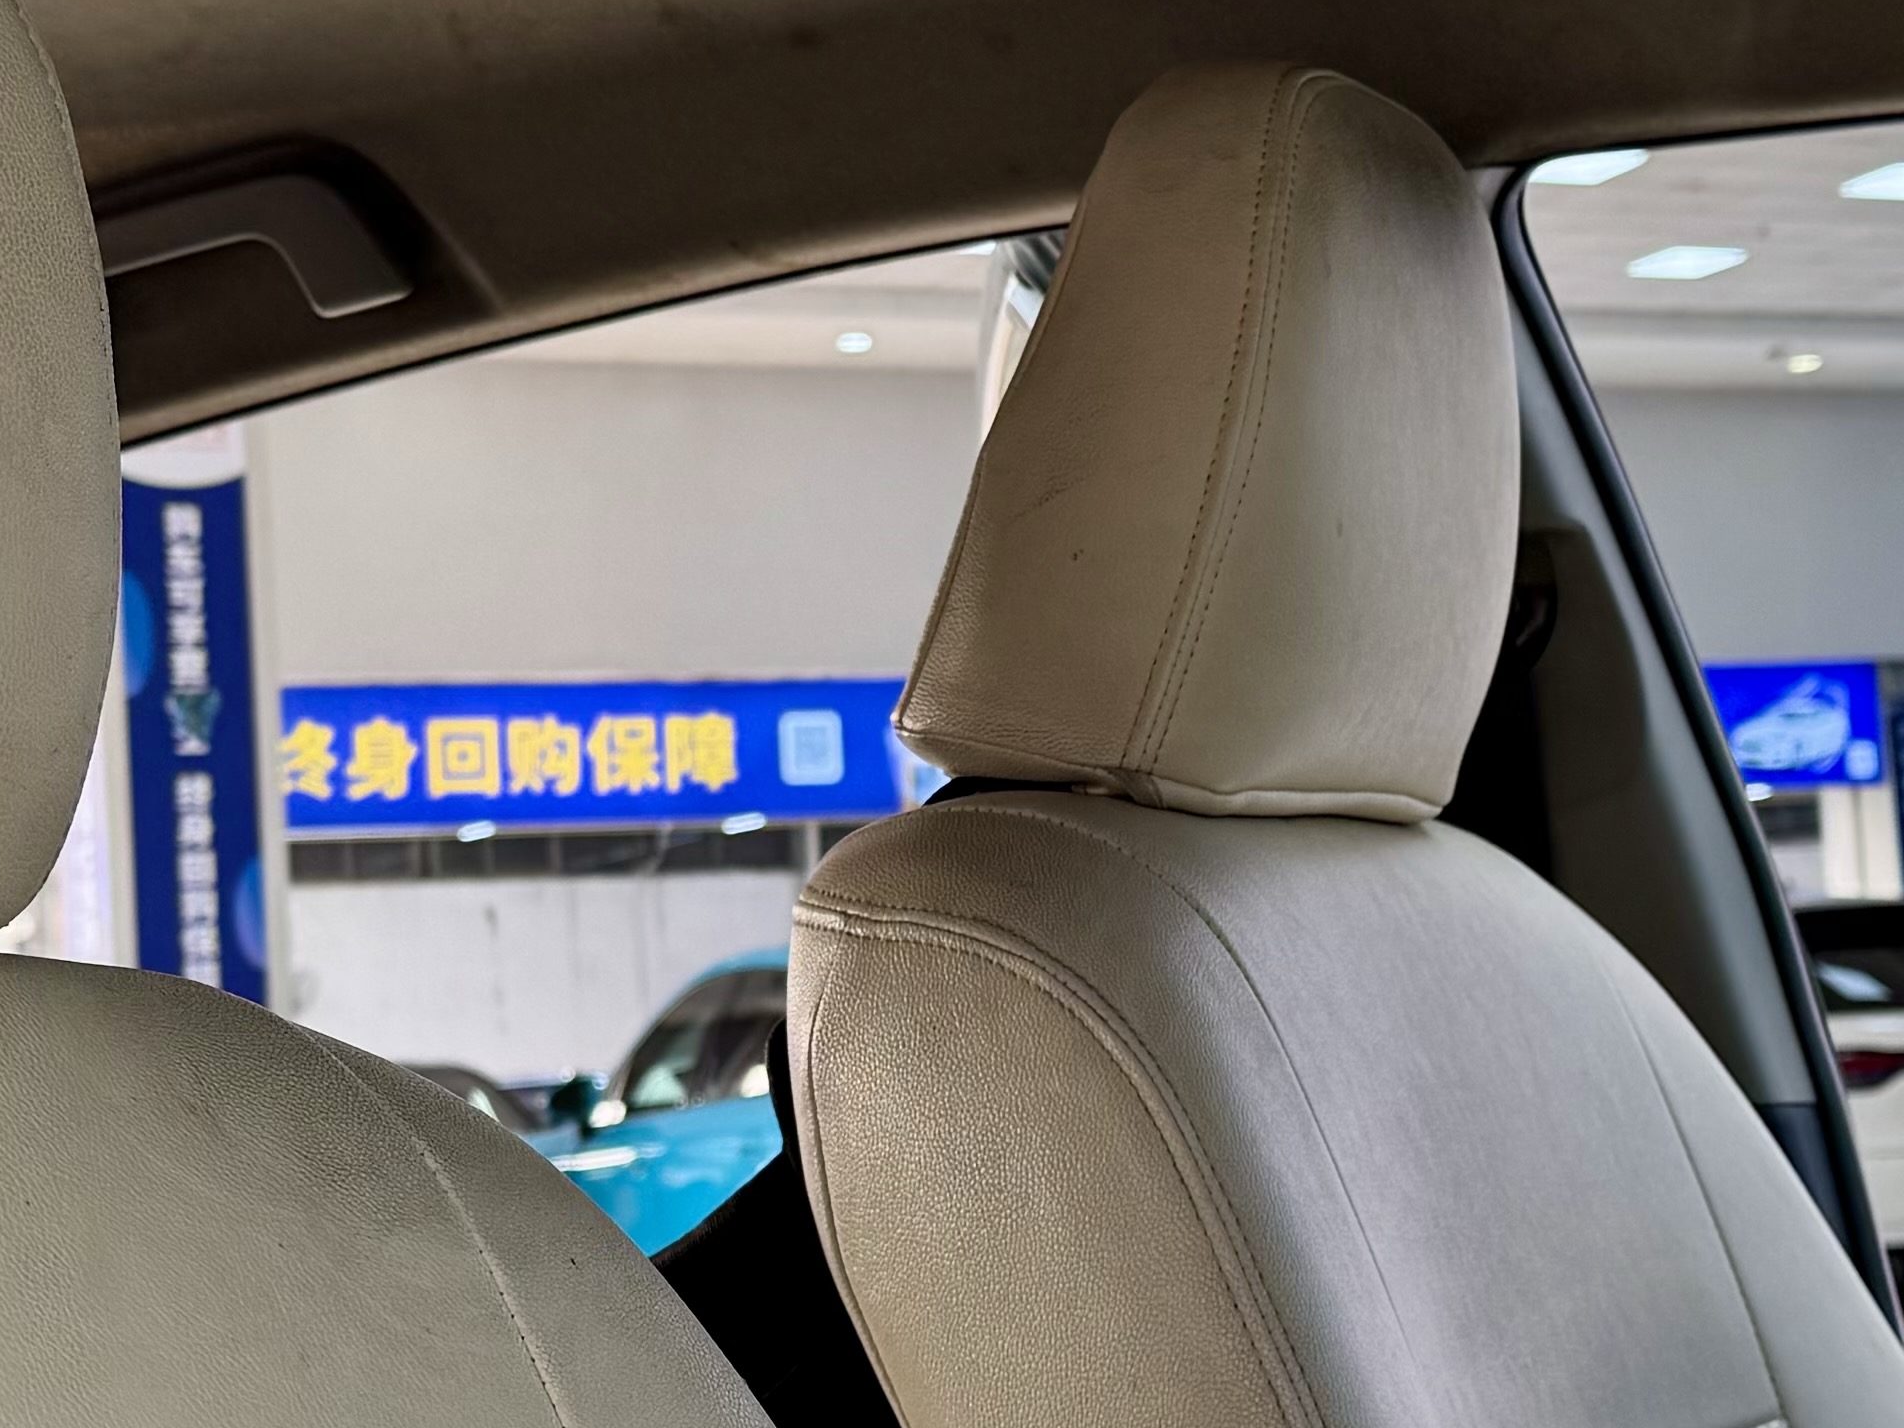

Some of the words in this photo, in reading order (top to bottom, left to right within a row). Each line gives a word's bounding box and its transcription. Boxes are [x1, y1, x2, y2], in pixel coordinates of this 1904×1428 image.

[278, 711, 739, 800] 终身回购保障
